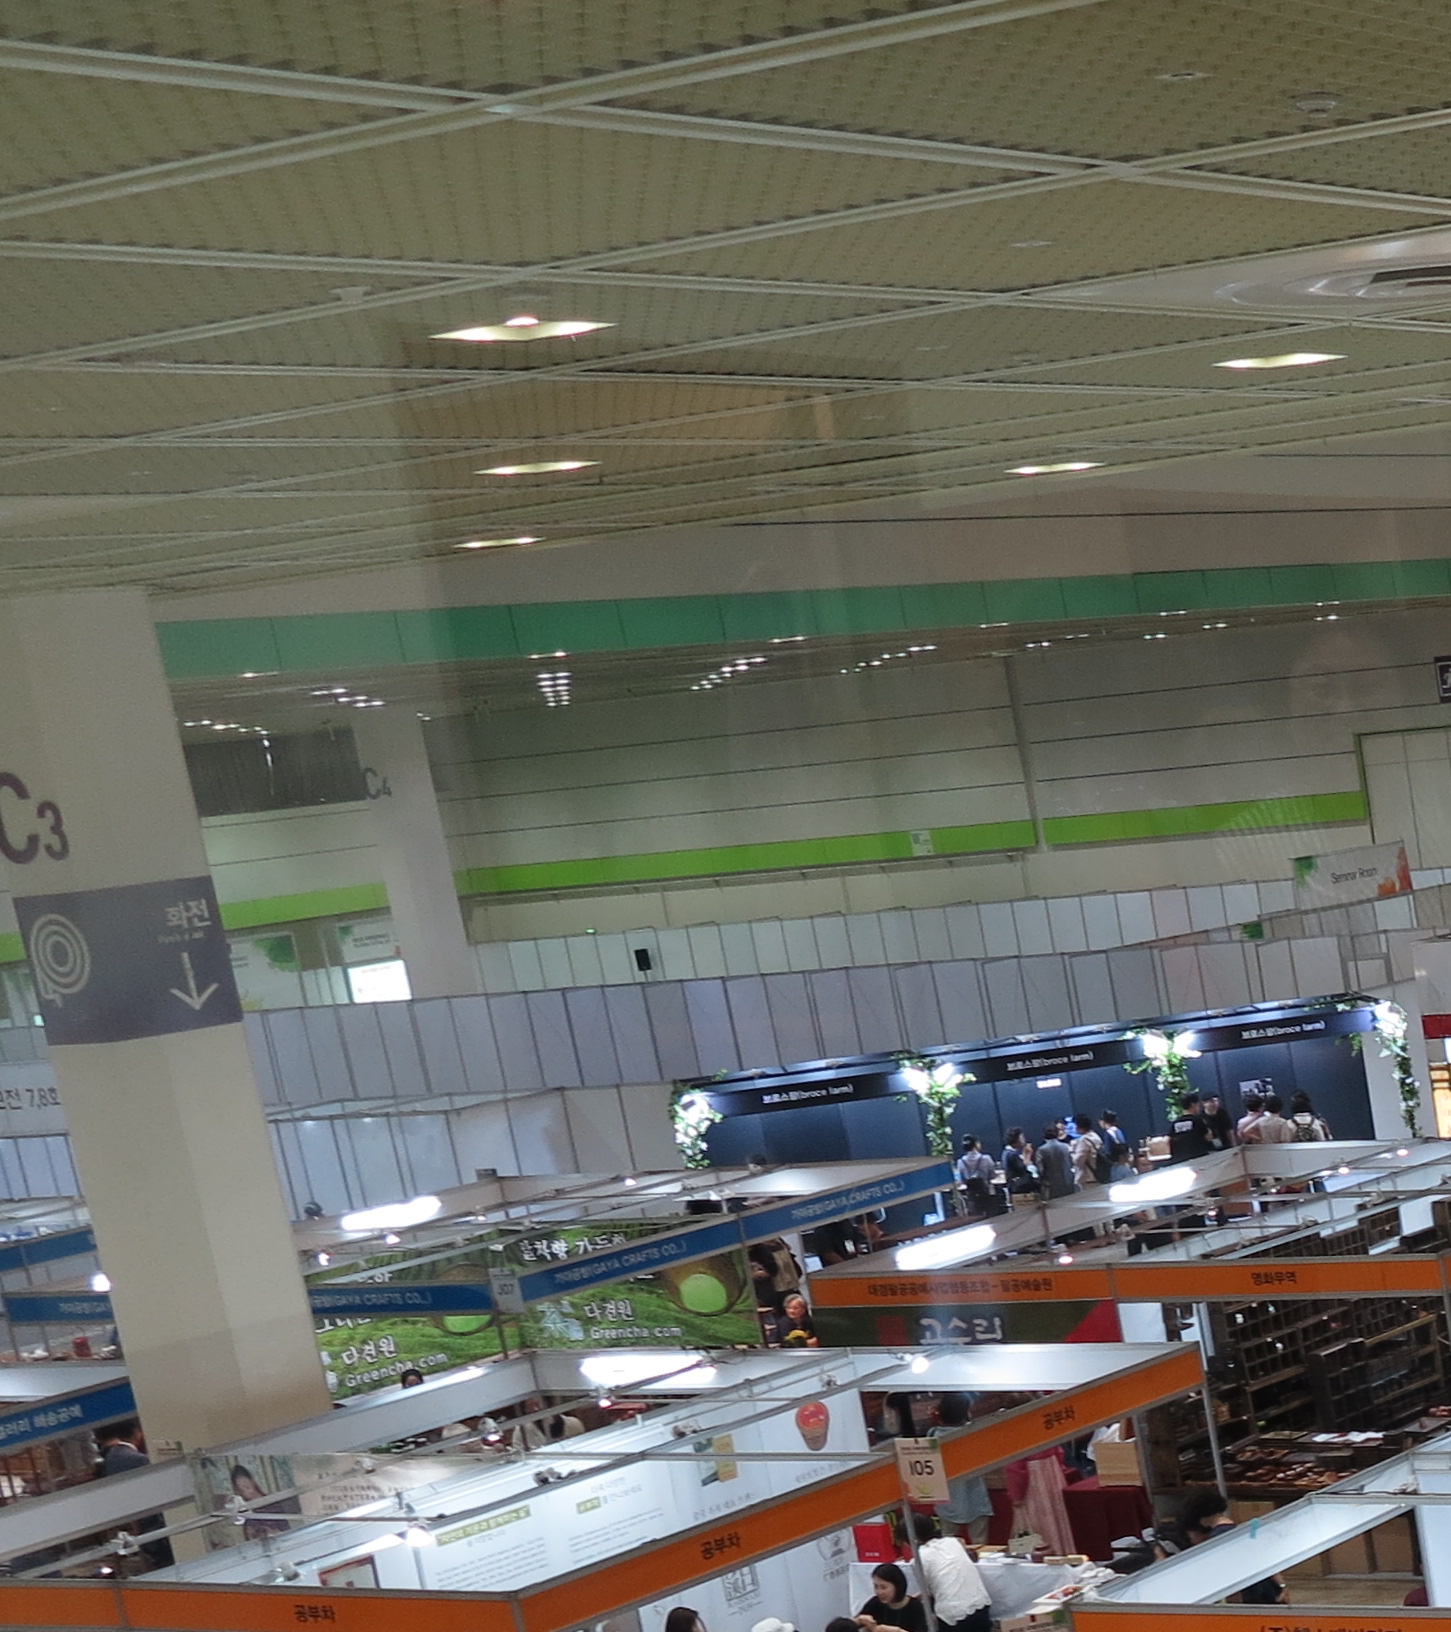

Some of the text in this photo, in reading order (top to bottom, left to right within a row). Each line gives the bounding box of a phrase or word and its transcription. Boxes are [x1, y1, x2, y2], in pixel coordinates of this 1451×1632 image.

[364, 767, 392, 800] C4
[0, 771, 70, 864] C3
[1042, 1404, 1076, 1430] 공부차
[700, 1531, 742, 1560] 공부차
[294, 1604, 336, 1624] 공부차
